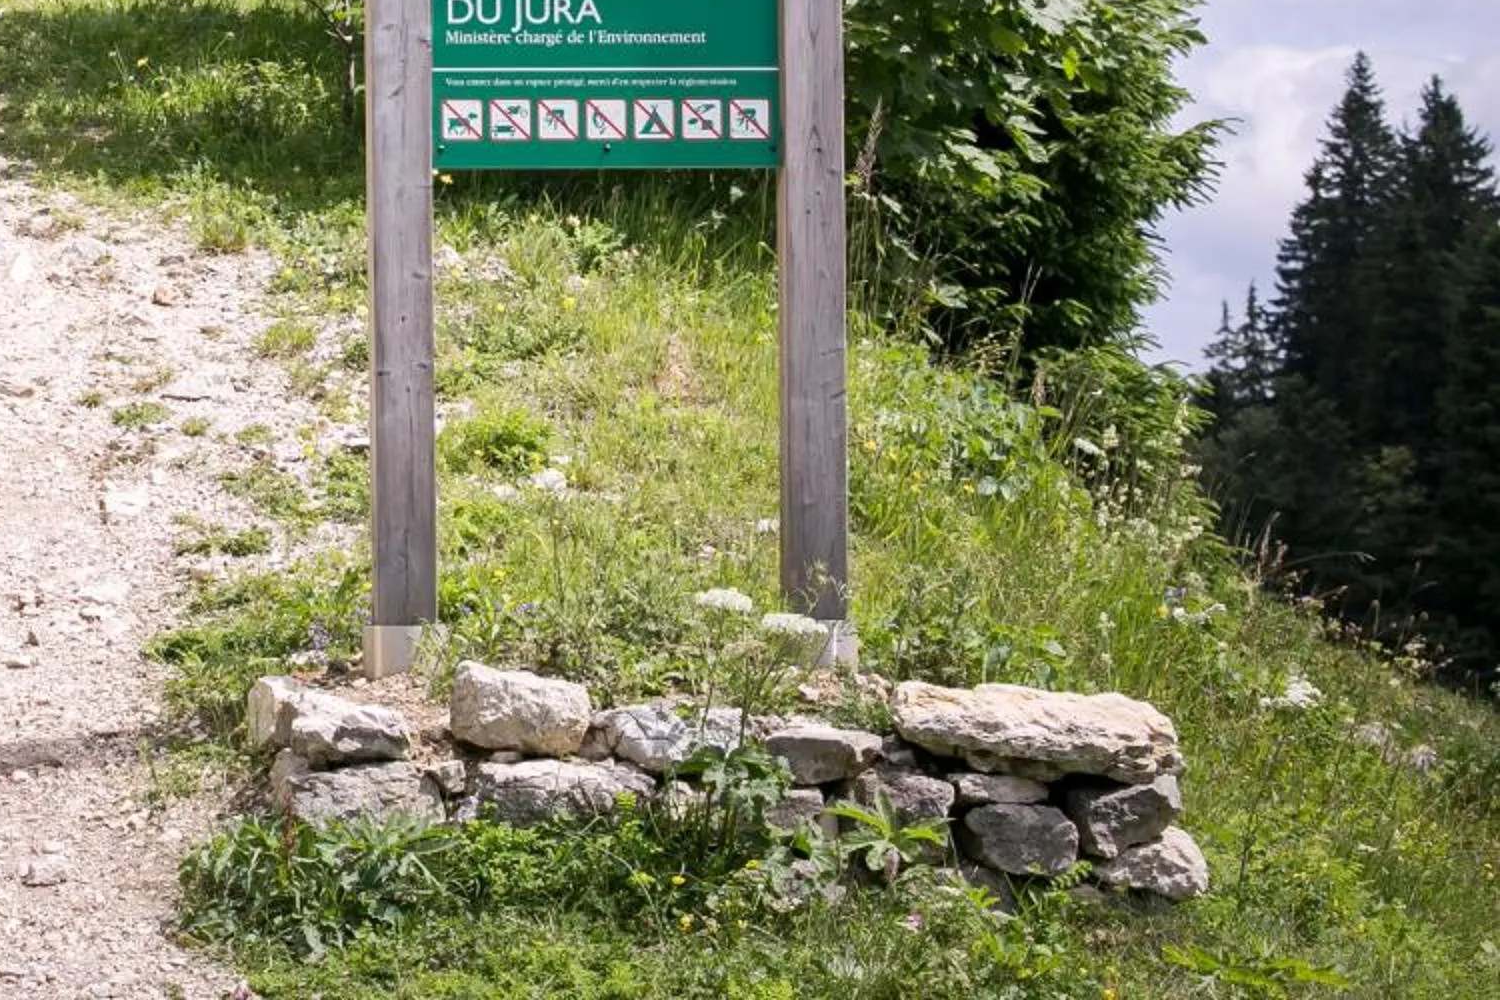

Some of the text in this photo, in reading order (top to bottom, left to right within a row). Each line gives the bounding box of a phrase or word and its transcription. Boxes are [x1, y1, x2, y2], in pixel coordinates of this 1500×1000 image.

[445, 29, 707, 47] Ministère chargé de l'Environnement
